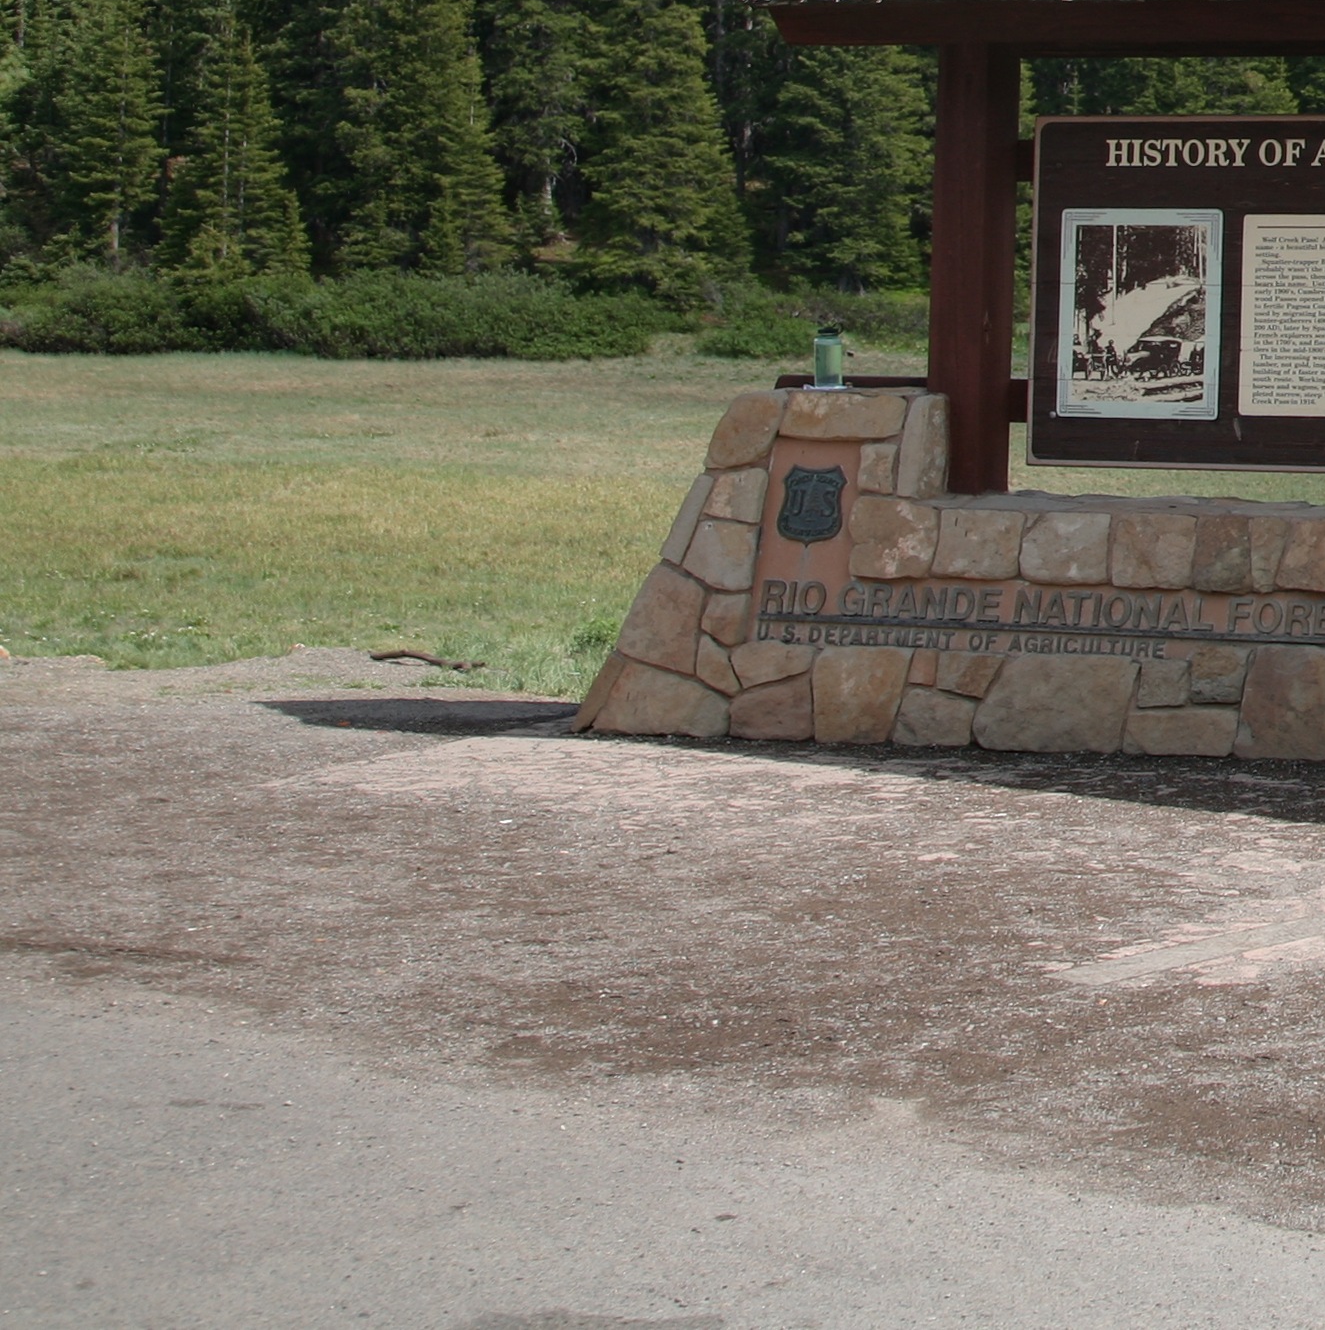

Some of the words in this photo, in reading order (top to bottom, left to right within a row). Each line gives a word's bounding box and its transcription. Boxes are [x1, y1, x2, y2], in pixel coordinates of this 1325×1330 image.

[1106, 138, 1251, 167] HISTORY
[1259, 139, 1306, 166] OF
[760, 579, 827, 617] RIO
[838, 581, 1001, 627] GRANDE
[1013, 587, 1216, 633] NATIONAL
[757, 623, 777, 642] U.
[781, 625, 802, 644] S.
[809, 625, 953, 651] DEPARTMENT
[969, 633, 998, 652] OF
[1008, 633, 1166, 659] AGRICULTURE
